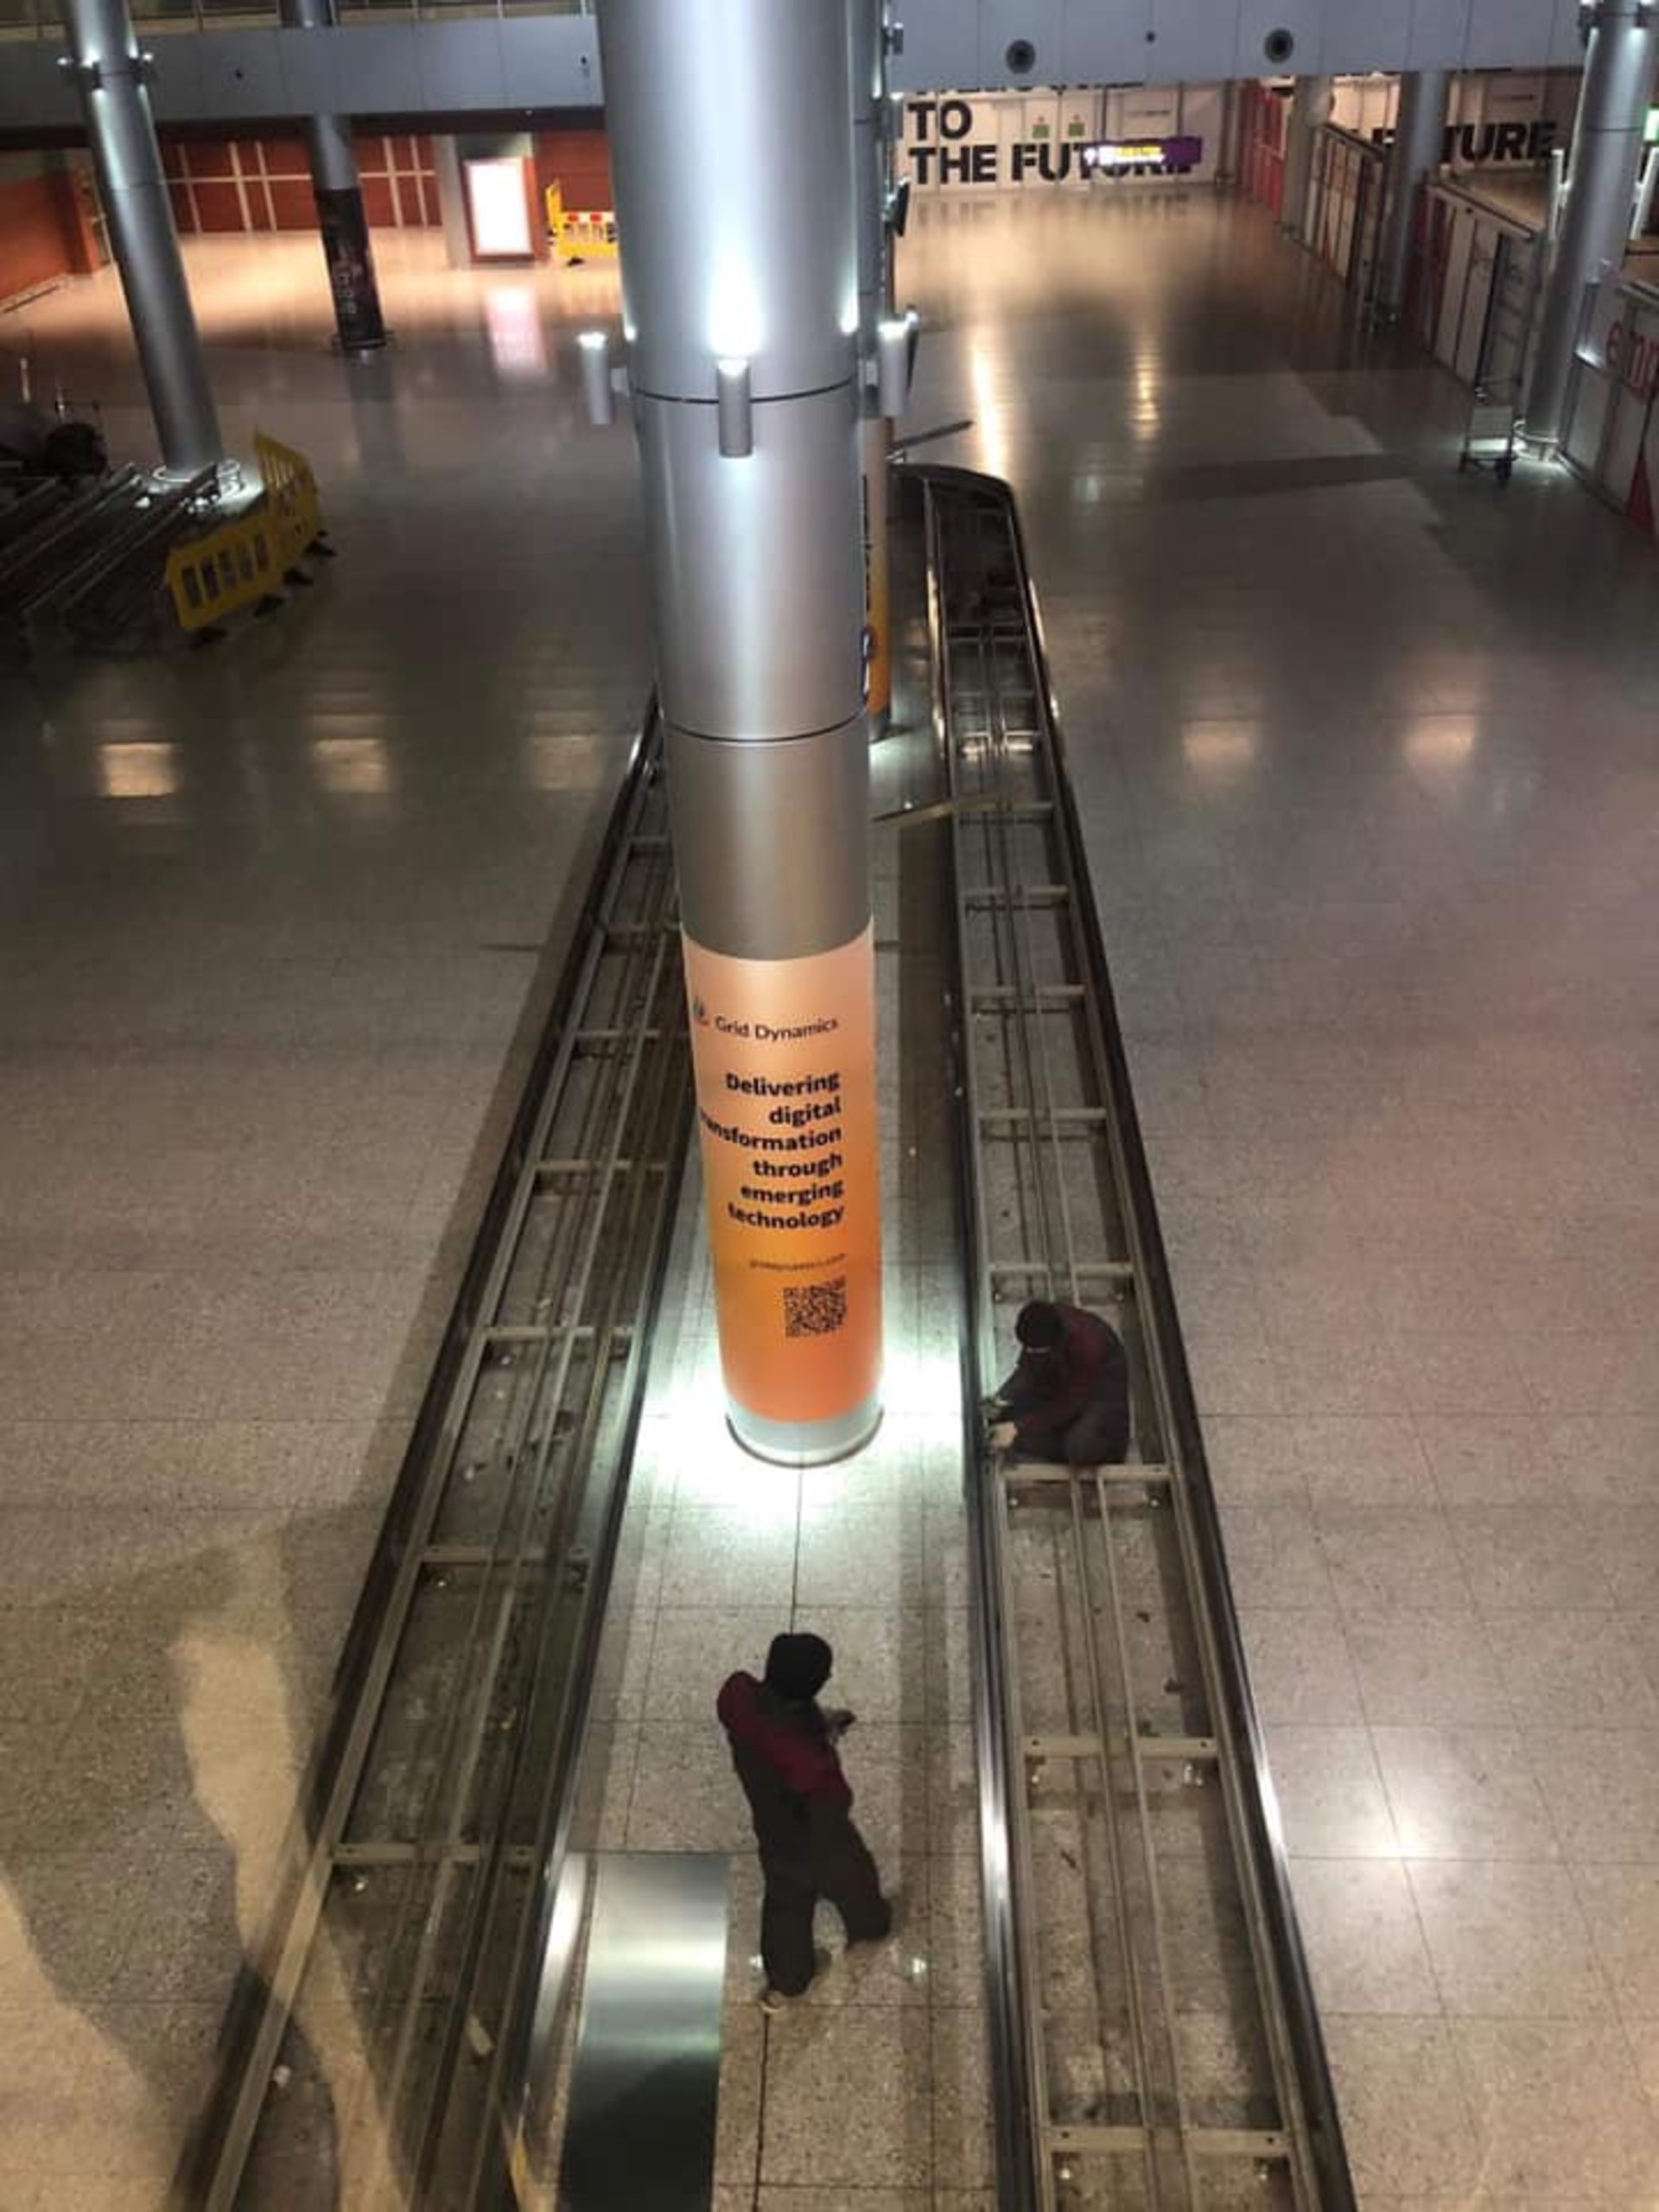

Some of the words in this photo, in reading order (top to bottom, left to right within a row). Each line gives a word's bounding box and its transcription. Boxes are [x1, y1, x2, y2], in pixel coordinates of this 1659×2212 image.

[908, 100, 972, 141] TO
[908, 144, 996, 184] THE
[715, 1015, 750, 1038] Grid
[754, 1017, 839, 1041] Dynamics
[726, 1071, 841, 1096] Delivering
[768, 1096, 842, 1127] digital
[752, 1153, 843, 1178] through
[741, 1179, 844, 1206] emerging
[728, 1202, 845, 1230] technology
